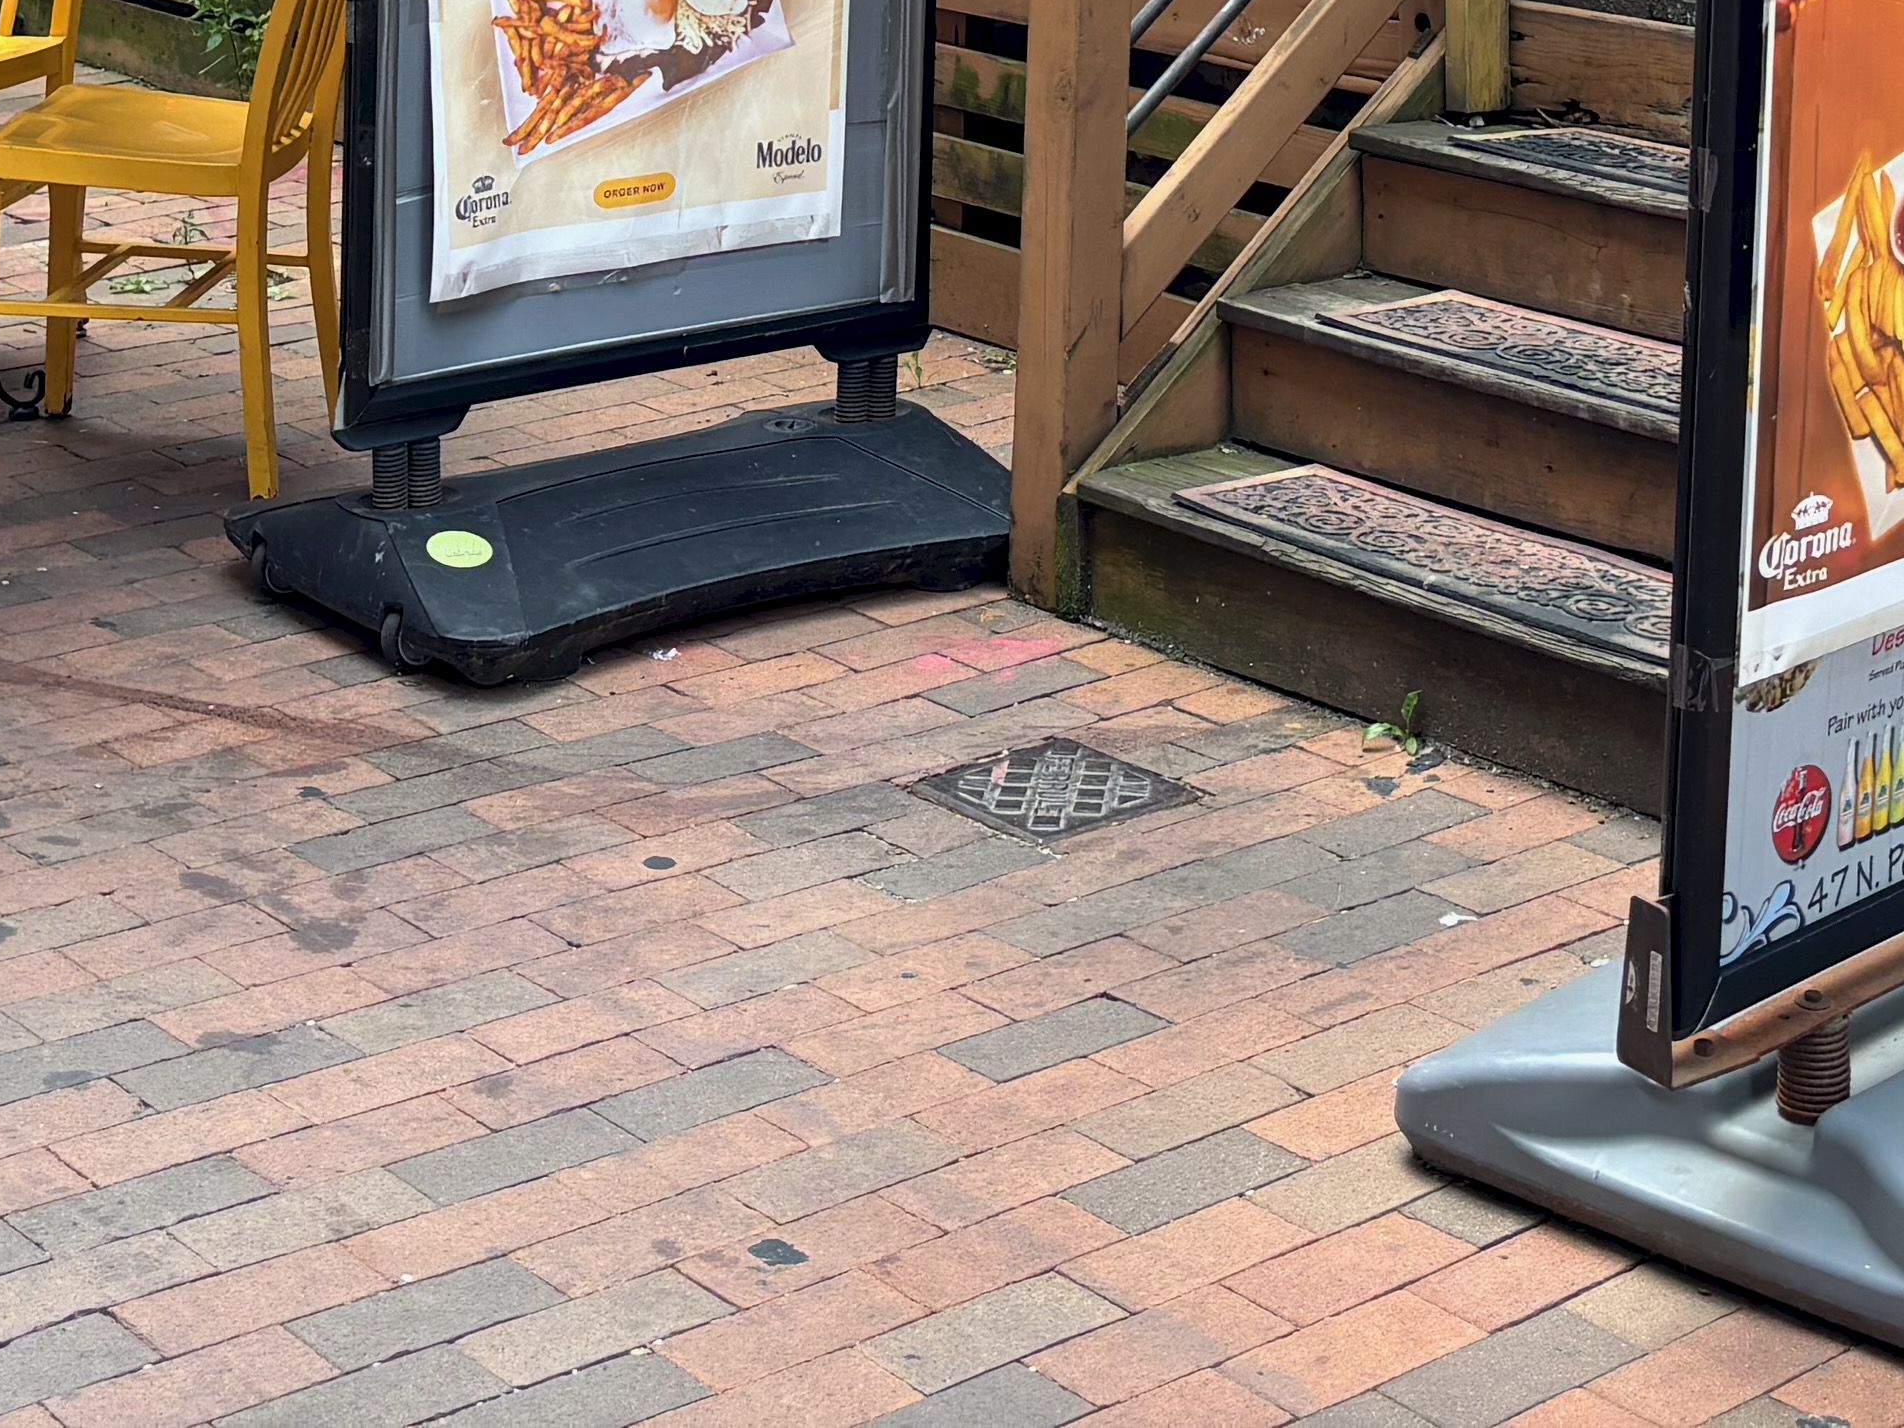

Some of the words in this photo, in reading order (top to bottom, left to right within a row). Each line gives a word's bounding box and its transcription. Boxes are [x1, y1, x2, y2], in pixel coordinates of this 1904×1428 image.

[756, 140, 822, 172] Modelo
[454, 190, 509, 223] Corona
[604, 184, 639, 201] ORDER
[642, 180, 665, 197] NOW
[472, 213, 497, 228] Extra
[1759, 517, 1853, 580] Corona
[1783, 565, 1828, 591] Extra
[1828, 713, 1854, 736] Pair
[1857, 701, 1885, 725] with
[1806, 871, 1848, 914] 47
[1854, 857, 1881, 893] N.
